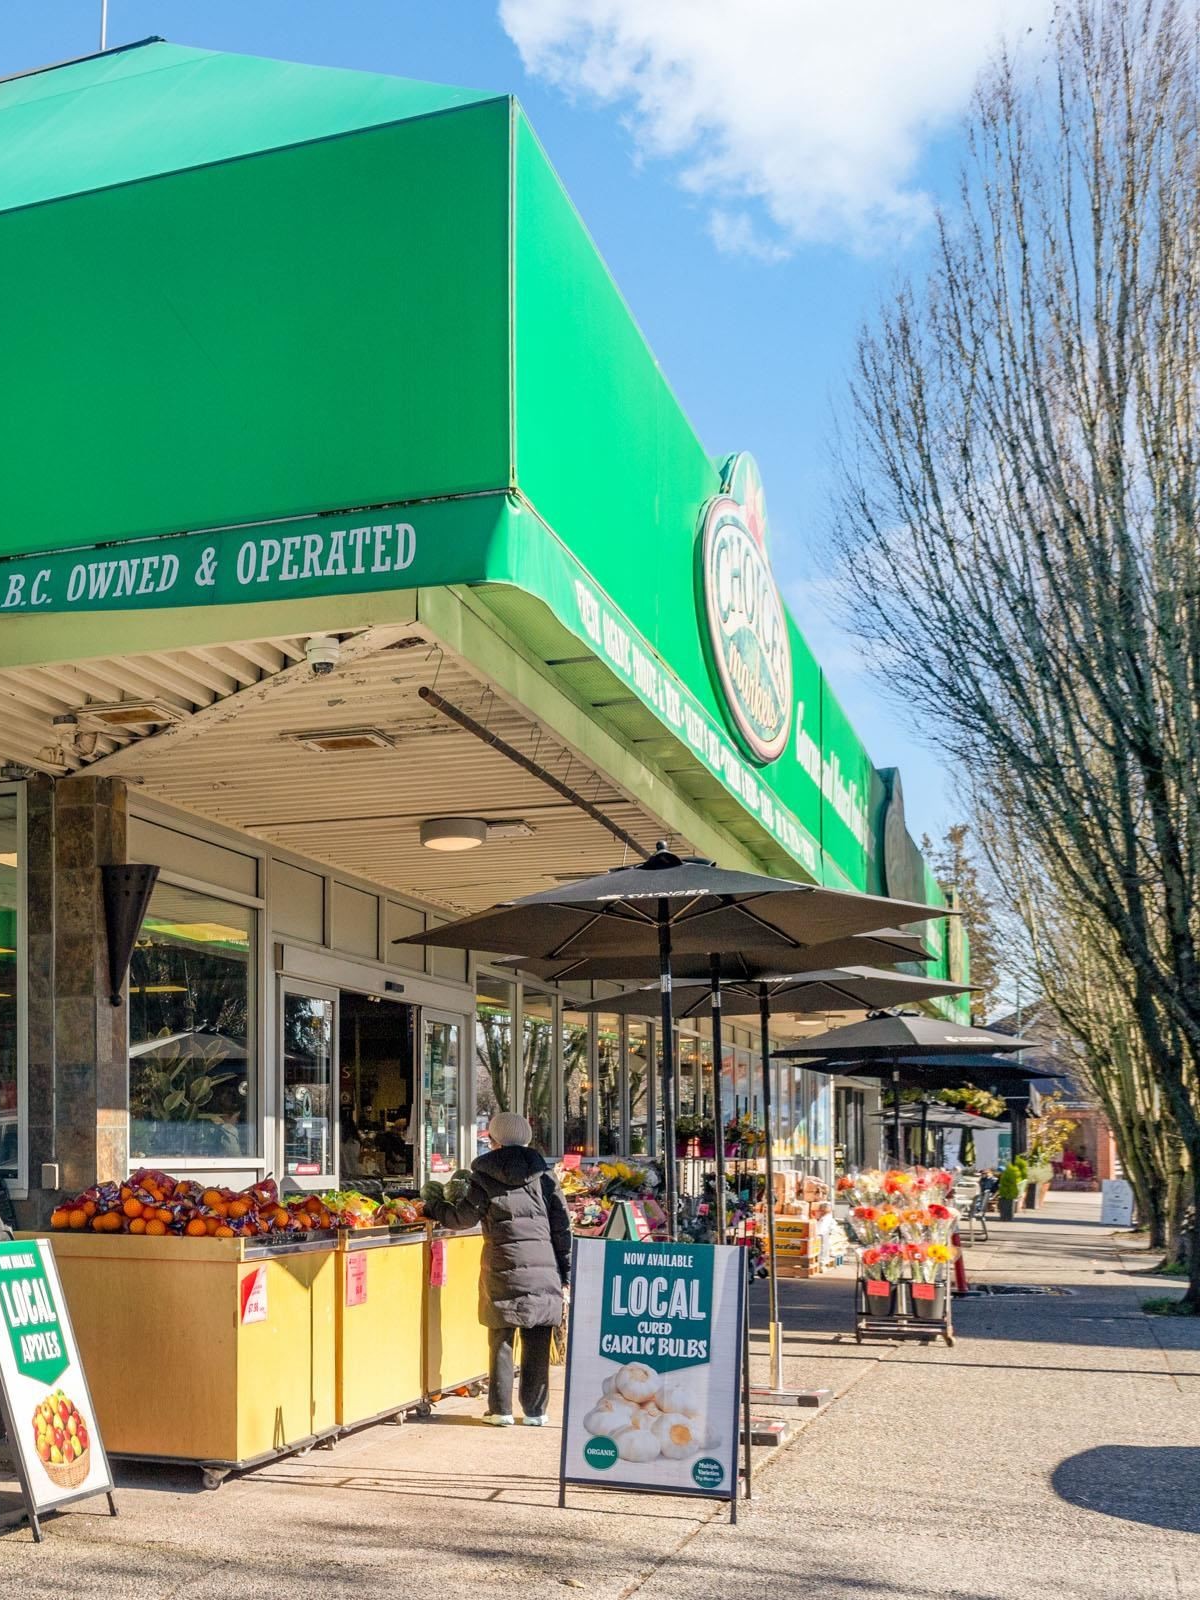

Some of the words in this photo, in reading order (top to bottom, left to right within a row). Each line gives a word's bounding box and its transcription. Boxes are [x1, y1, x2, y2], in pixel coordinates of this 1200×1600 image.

[0, 569, 53, 608] B.C.
[66, 554, 180, 602] OWNED
[195, 547, 218, 587] &
[236, 523, 417, 585] OPERATED
[715, 533, 786, 708] CHOICES
[623, 1252, 646, 1266] NOW
[647, 1253, 694, 1268] AVAILABLE
[1, 1278, 57, 1328] LOCAL
[611, 1275, 706, 1321] LOCAL
[637, 1321, 672, 1335] CURED
[20, 1330, 61, 1363] APPLES
[601, 1334, 656, 1356] GARLIC
[657, 1337, 707, 1359] BULBS
[586, 1447, 616, 1457] ORGANIC
